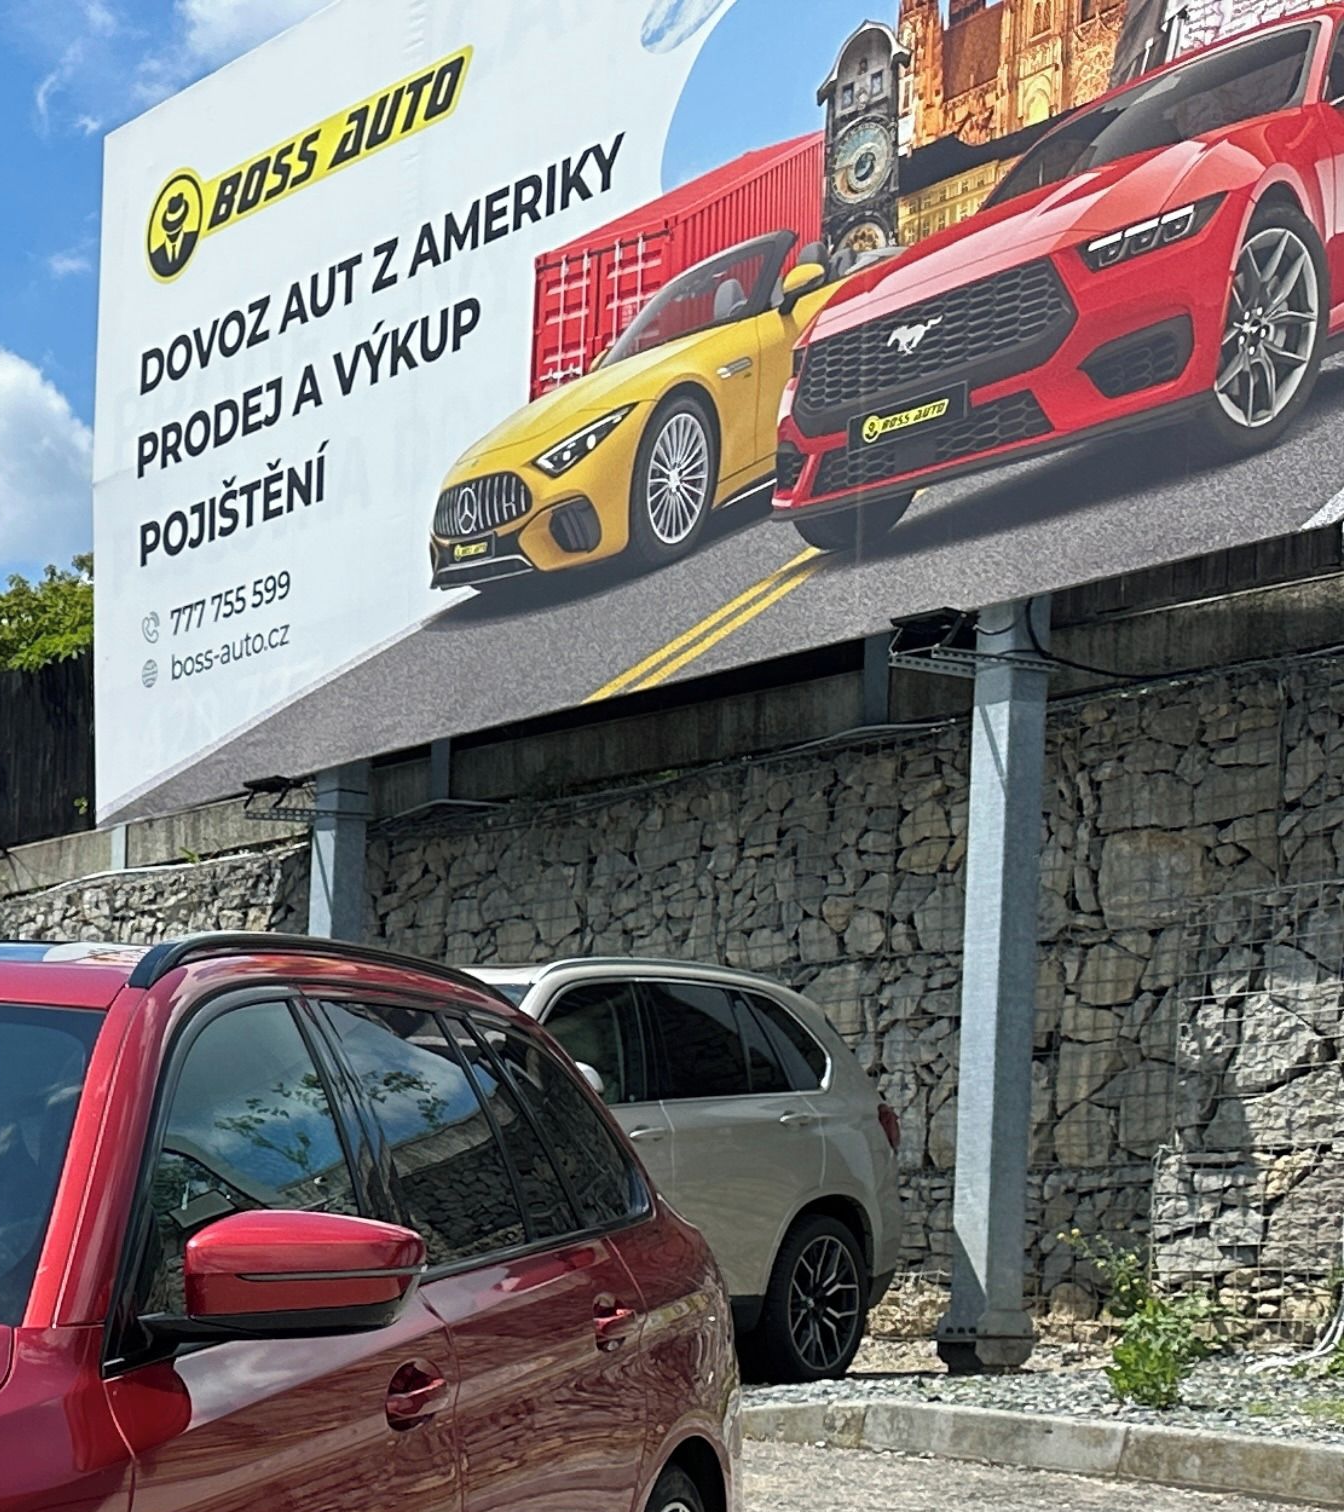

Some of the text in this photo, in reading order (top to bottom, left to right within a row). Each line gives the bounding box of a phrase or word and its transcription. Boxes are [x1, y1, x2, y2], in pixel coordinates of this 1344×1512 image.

[207, 55, 465, 231] BOSS AUTO
[140, 131, 626, 396] DOVOZ AUT Z AMERIKY
[137, 297, 481, 479] PRODEJ A VÝKUP
[881, 402, 946, 430] BOSS AUTO
[140, 439, 330, 568] POJIŠTĚNÍ
[170, 570, 291, 636] 777 755 599
[171, 624, 290, 681] boss-auto.cz
